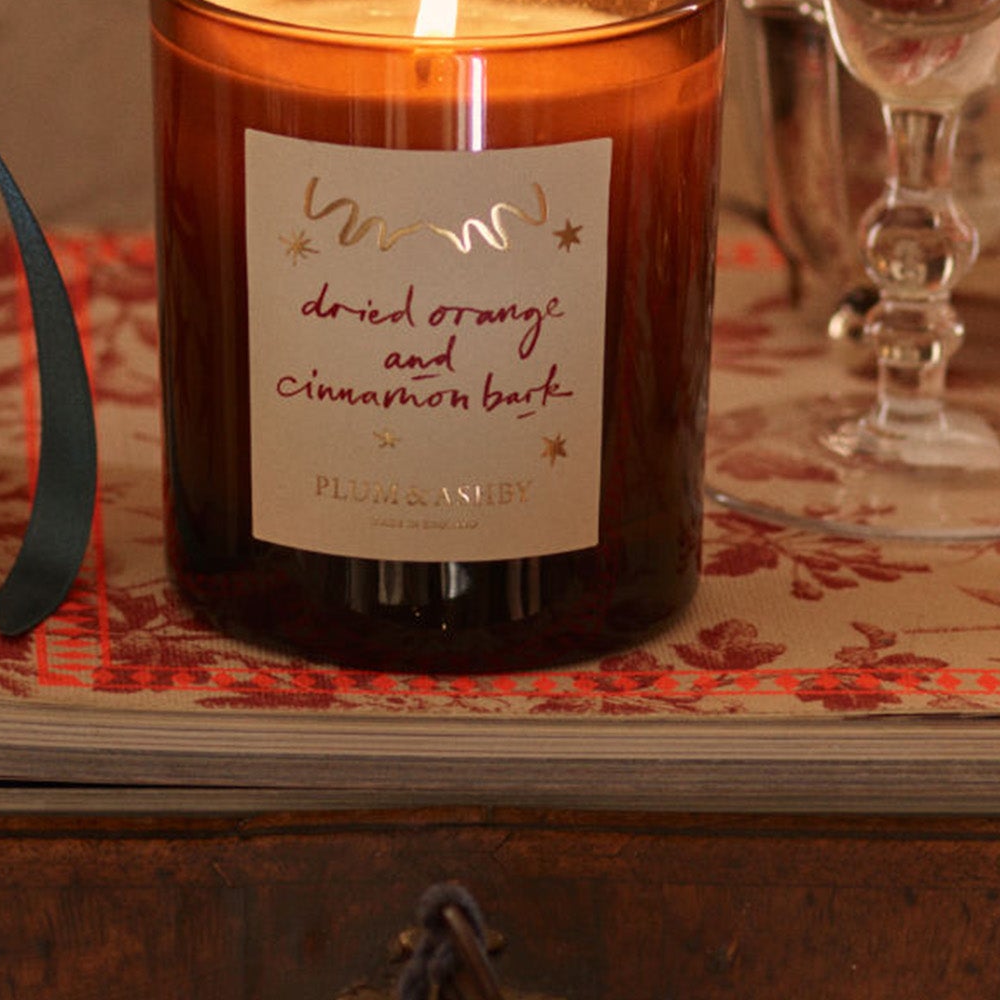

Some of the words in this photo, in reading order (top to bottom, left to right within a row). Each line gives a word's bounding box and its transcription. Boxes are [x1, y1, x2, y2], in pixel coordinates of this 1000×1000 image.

[301, 282, 415, 327] dried
[427, 297, 565, 360] orange
[384, 335, 455, 373] and
[276, 370, 469, 411] cinnamon
[482, 364, 574, 413] bark
[316, 474, 398, 505] PLUM
